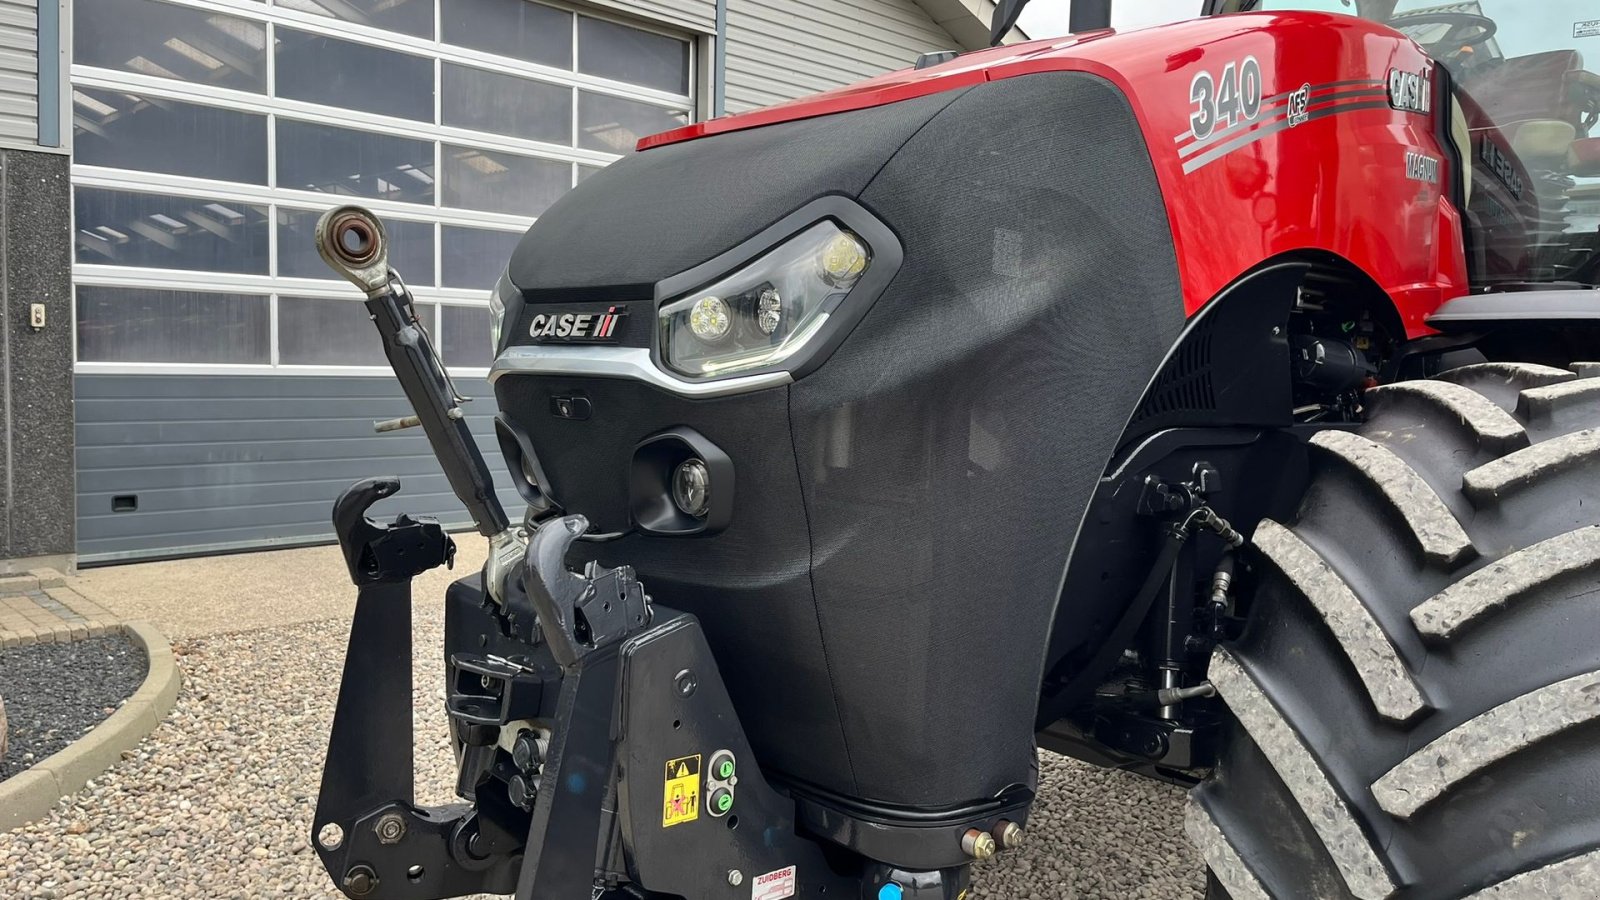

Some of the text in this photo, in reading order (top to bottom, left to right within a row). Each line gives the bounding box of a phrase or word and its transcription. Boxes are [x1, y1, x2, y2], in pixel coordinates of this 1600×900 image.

[1190, 55, 1262, 140] 340
[1288, 91, 1307, 117] AFS
[1406, 152, 1438, 184] MAGNUM
[529, 314, 592, 338] CASE
[757, 869, 792, 885] ZUIDBERG
